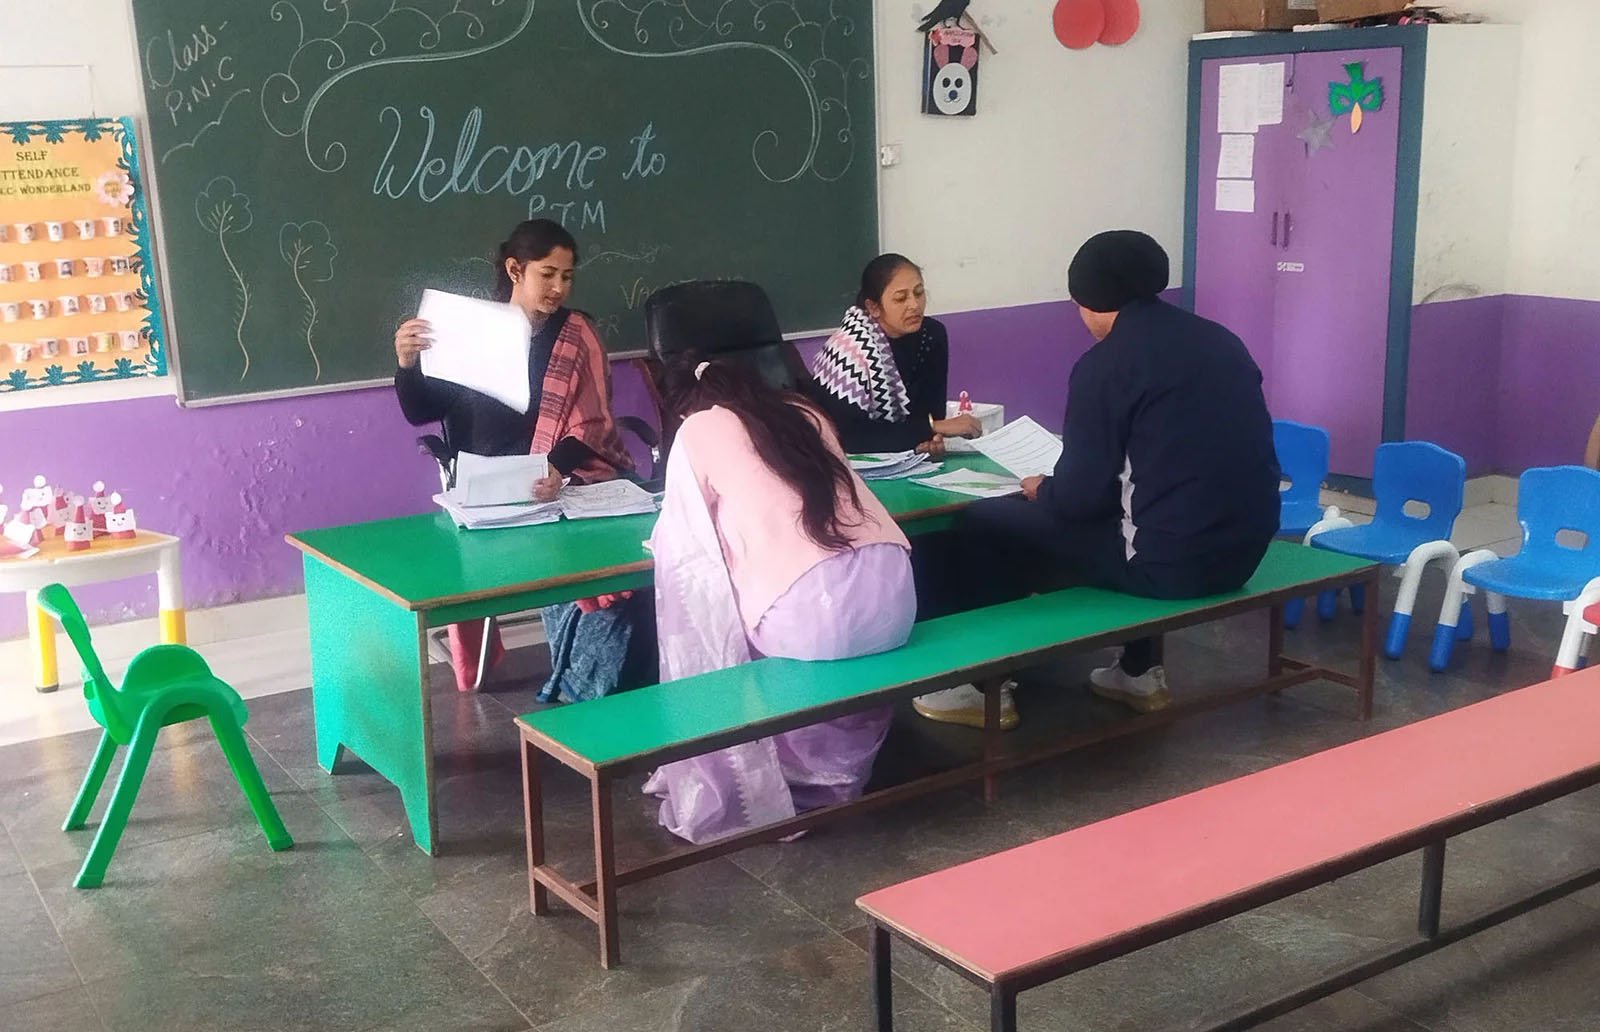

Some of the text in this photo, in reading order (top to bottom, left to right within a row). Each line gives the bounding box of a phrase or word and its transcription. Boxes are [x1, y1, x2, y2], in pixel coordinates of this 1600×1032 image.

[15, 149, 48, 162] SELF
[373, 105, 667, 203] Welcome to
[0, 166, 80, 181] TTENDANCE
[19, 182, 91, 195] WONDERLAND
